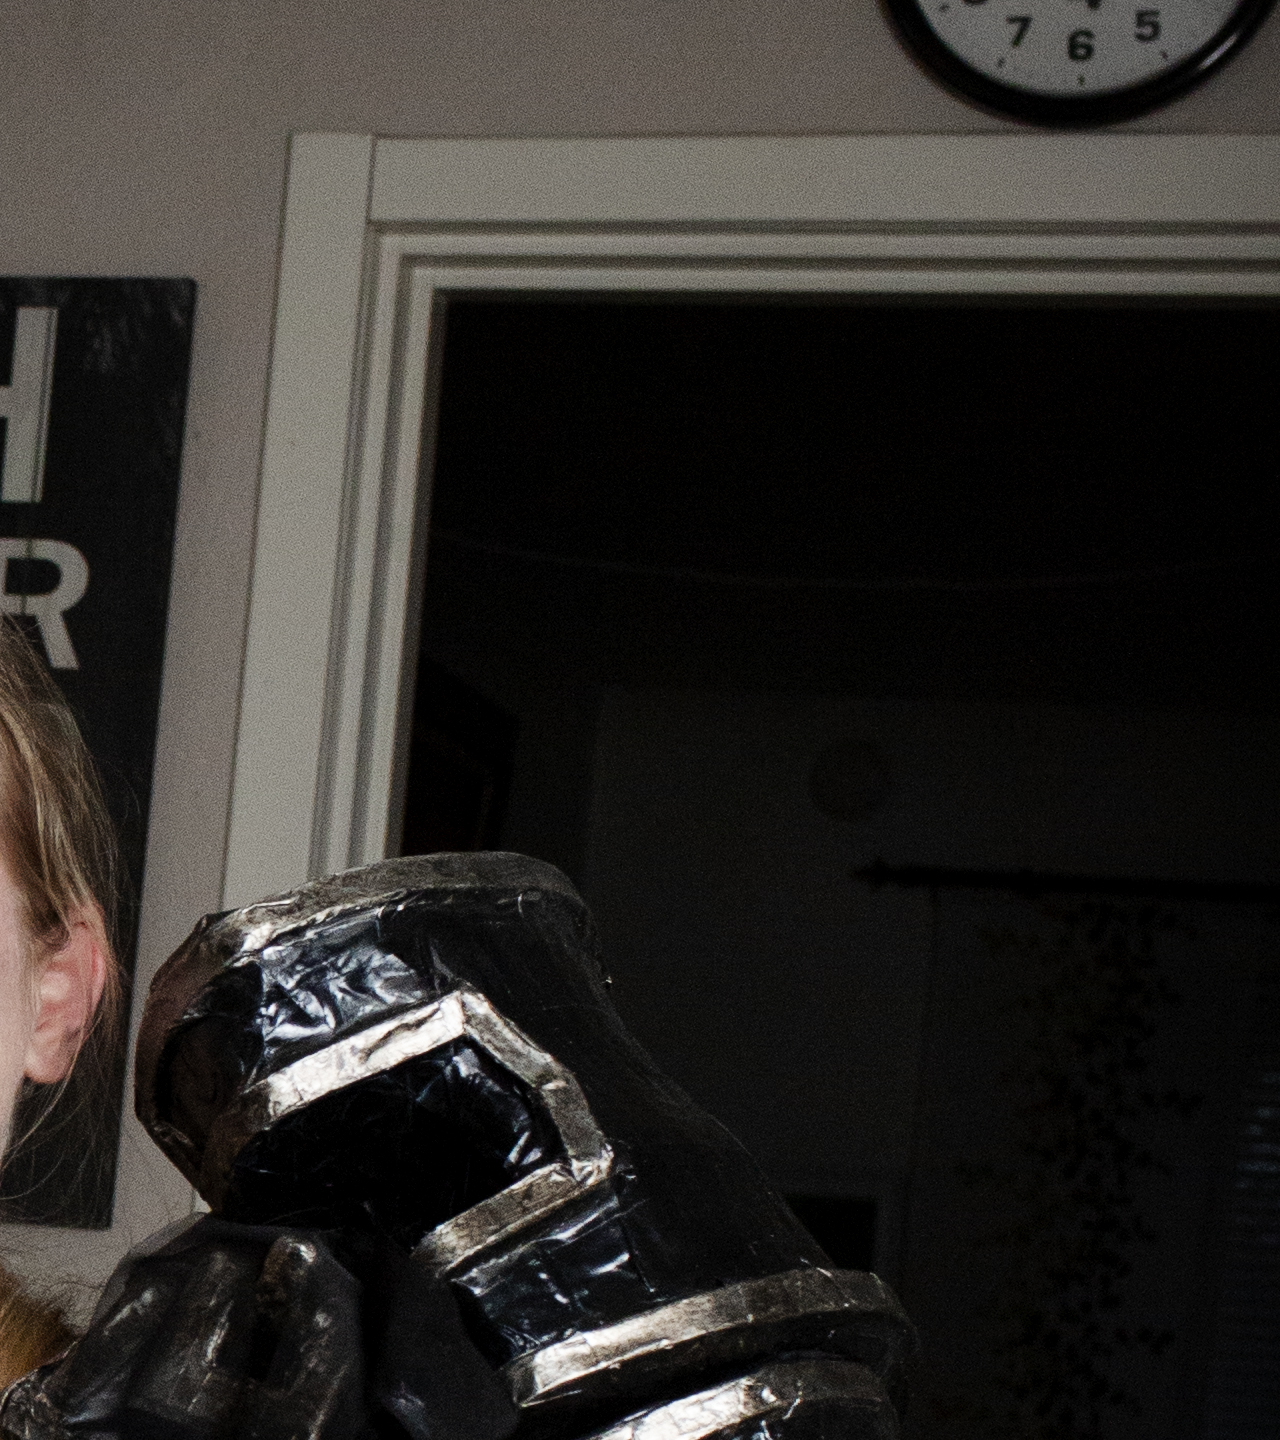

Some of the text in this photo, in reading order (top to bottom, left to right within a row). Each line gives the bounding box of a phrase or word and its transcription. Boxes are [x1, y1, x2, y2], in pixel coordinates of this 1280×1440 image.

[1006, 15, 1033, 47] 7
[1134, 10, 1162, 42] 5
[1066, 29, 1095, 62] 6
